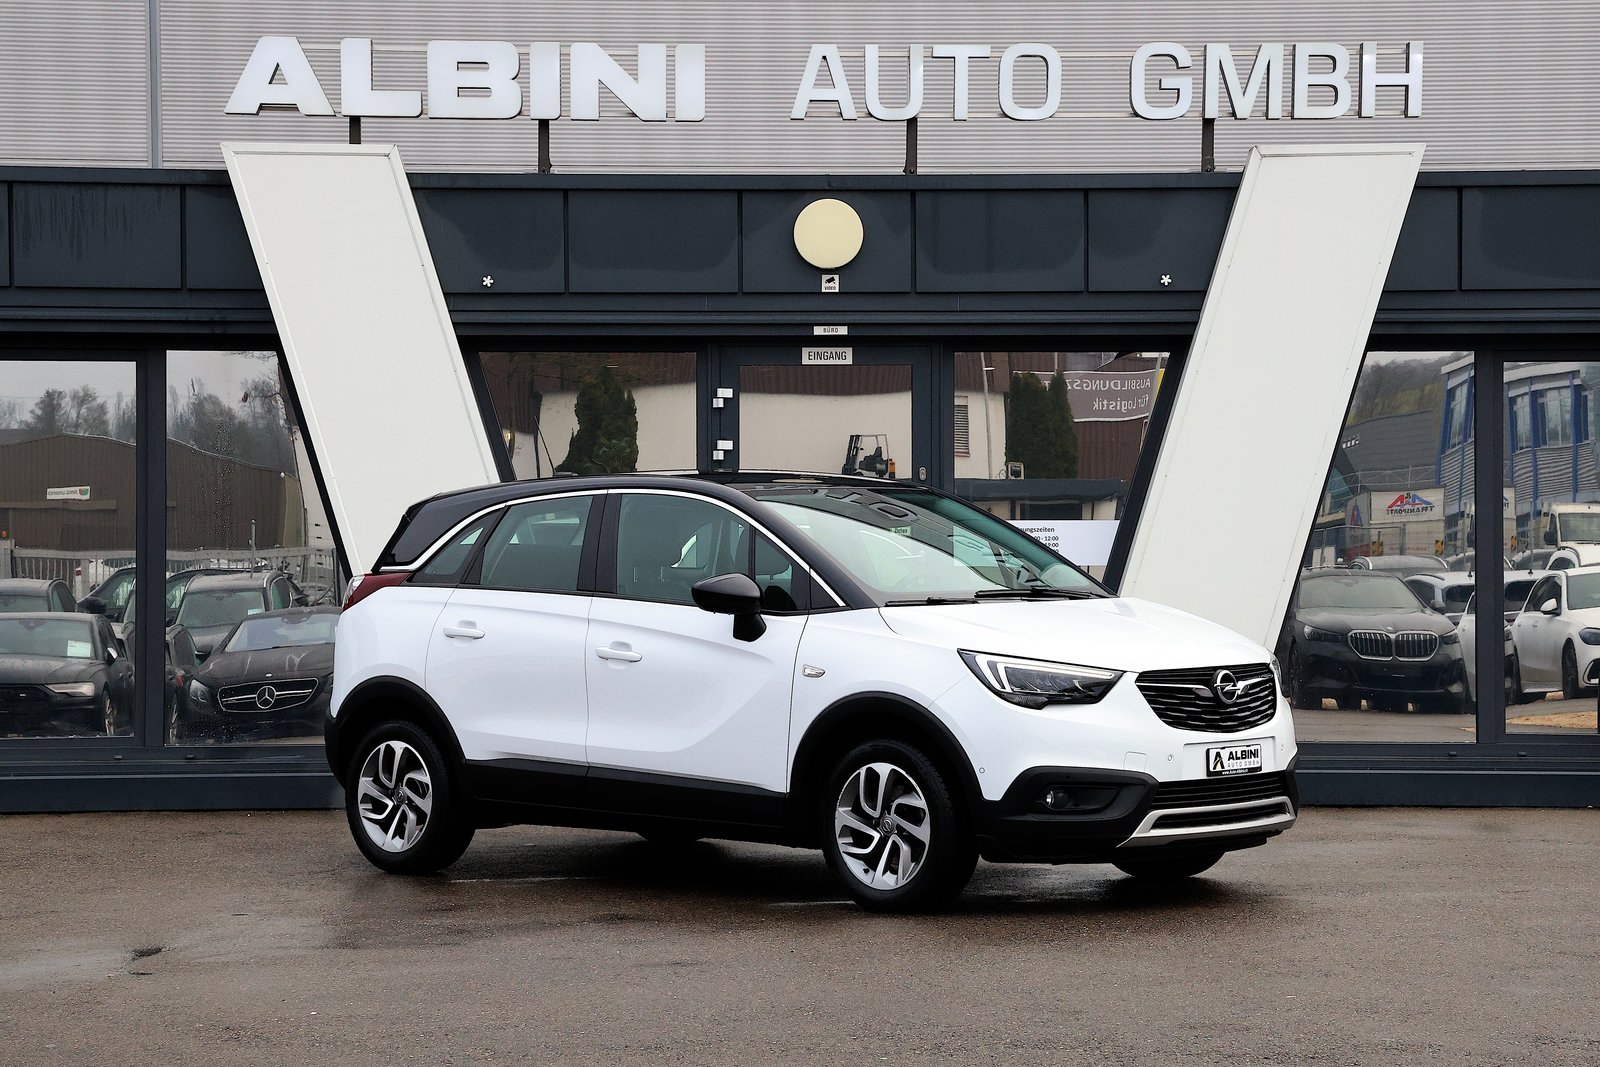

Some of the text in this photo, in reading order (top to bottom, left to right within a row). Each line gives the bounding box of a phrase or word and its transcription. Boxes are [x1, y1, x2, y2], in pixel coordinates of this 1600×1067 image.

[224, 36, 1425, 121] ALBINI AUTO GMBH
[808, 351, 847, 361] EINGANG
[1227, 748, 1259, 761] ALBINI
